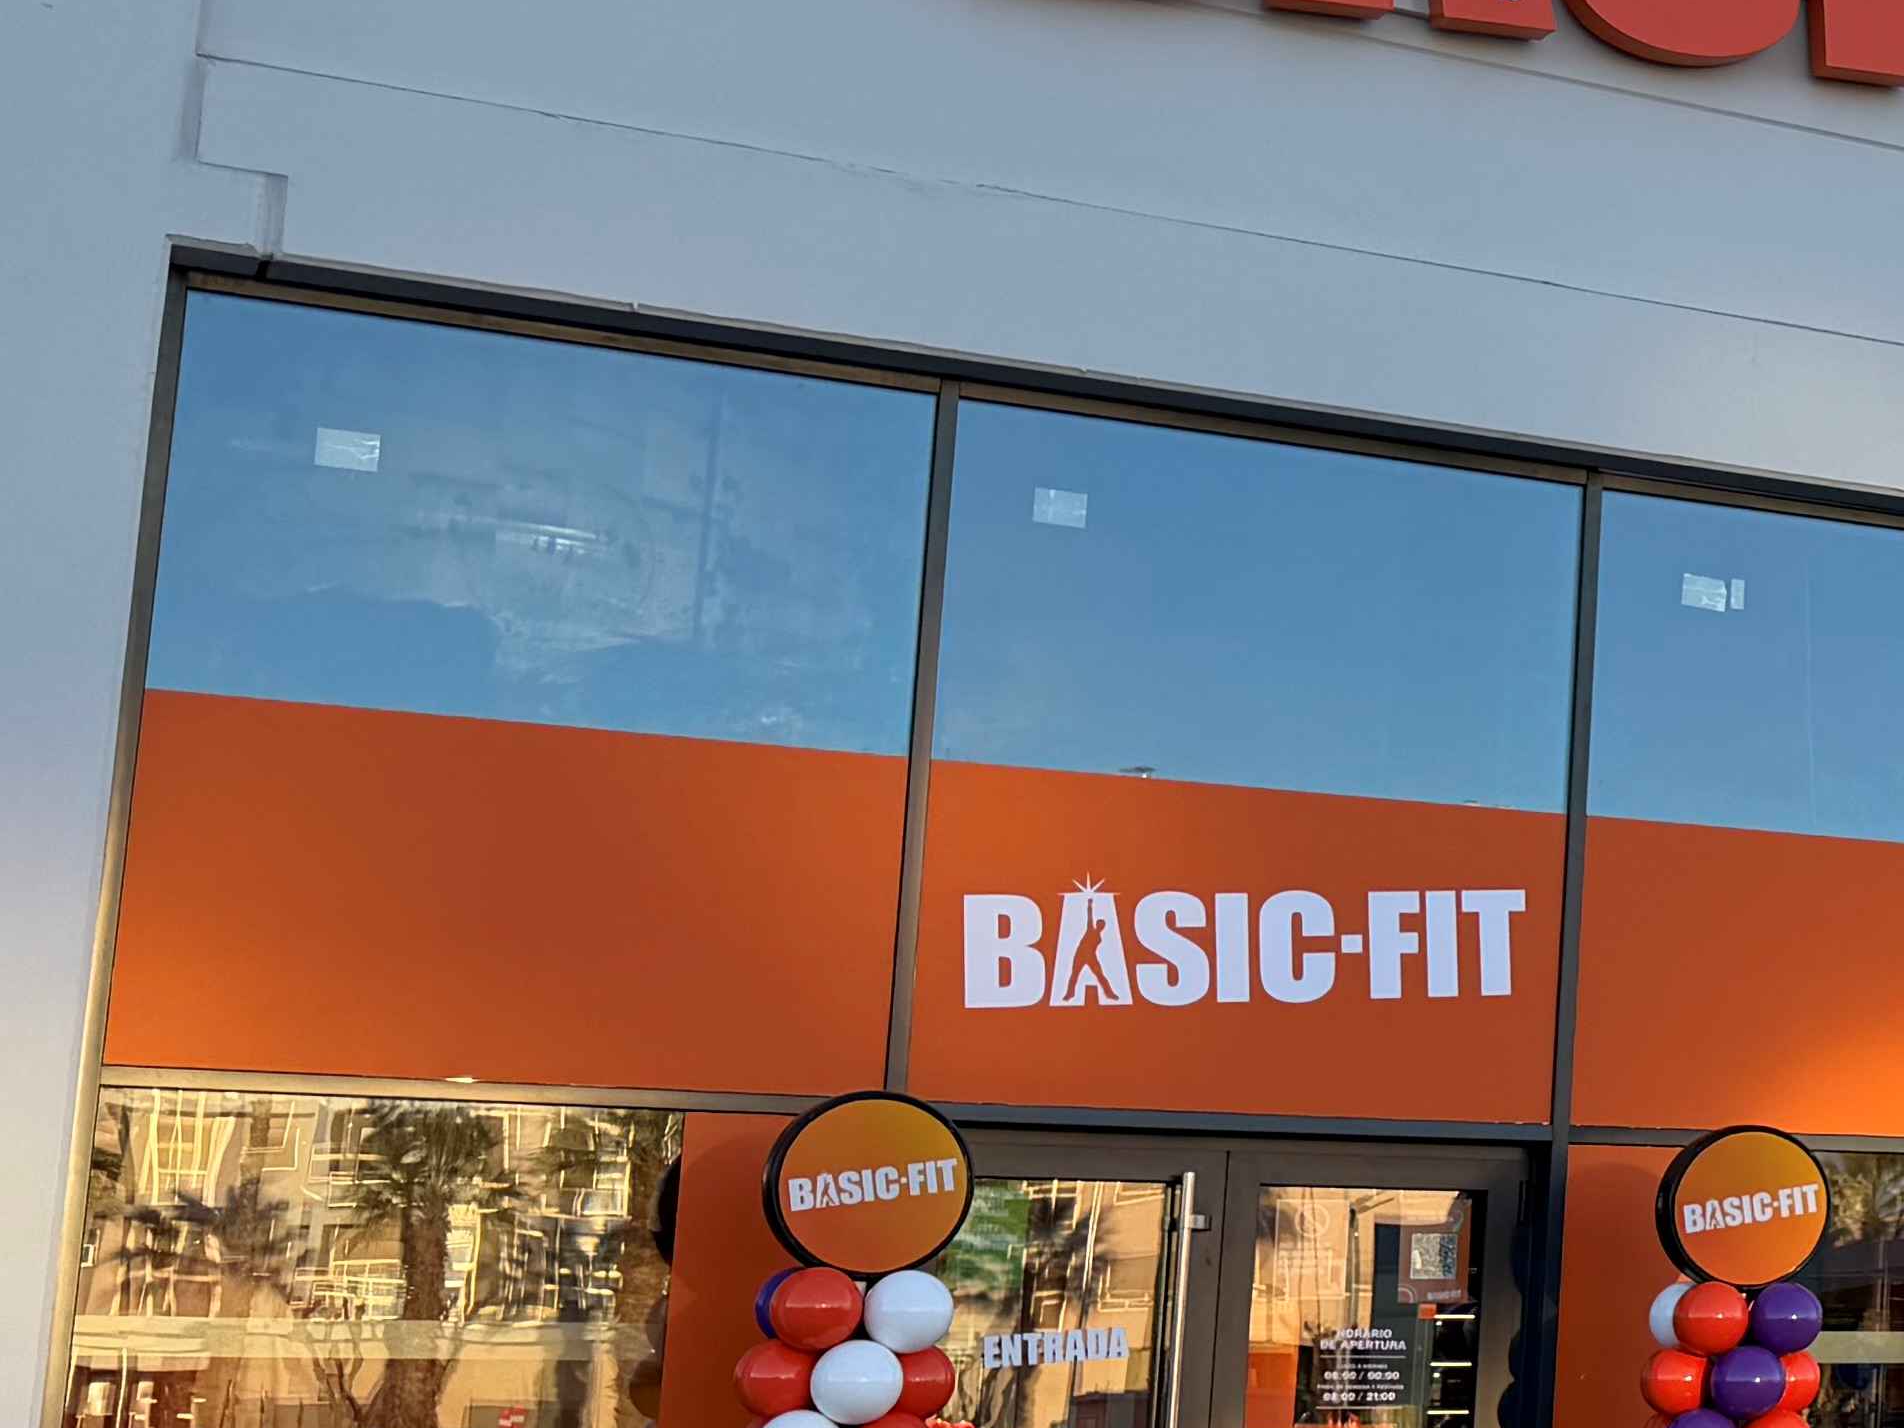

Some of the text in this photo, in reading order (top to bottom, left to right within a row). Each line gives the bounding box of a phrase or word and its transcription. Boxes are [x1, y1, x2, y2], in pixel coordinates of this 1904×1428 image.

[963, 874, 1526, 1008] BASIC-FIT
[787, 1157, 958, 1213] BASIC-FIT
[1682, 1183, 1819, 1235] BASIC-FIT
[983, 1328, 1130, 1369] ENTRADA
[1340, 1339, 1407, 1351] APERTURA
